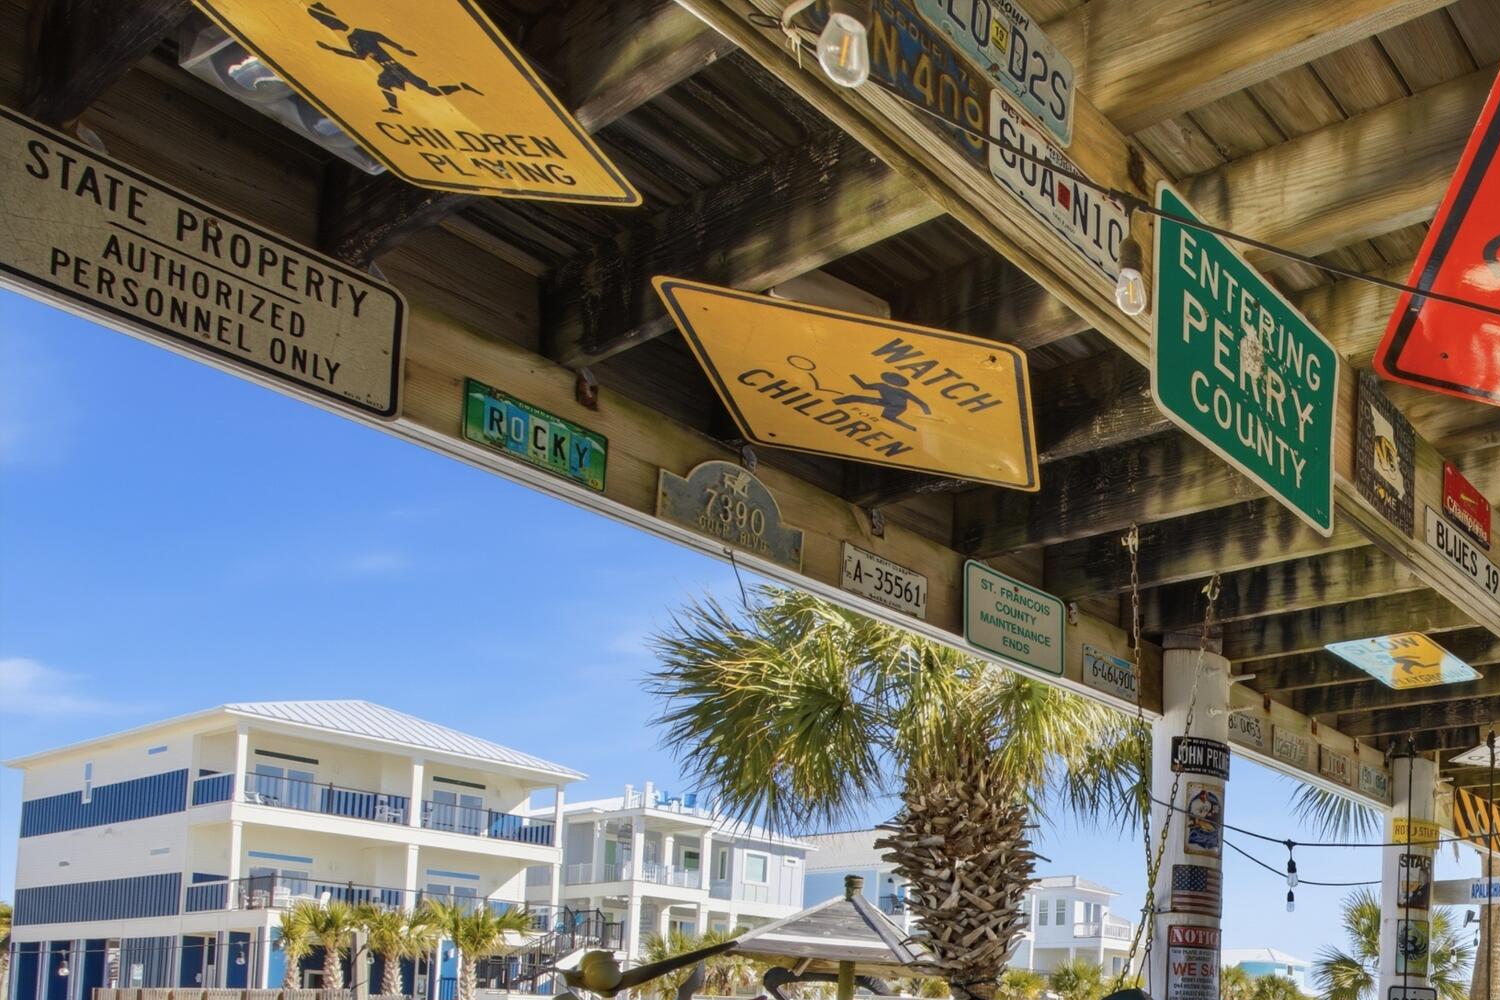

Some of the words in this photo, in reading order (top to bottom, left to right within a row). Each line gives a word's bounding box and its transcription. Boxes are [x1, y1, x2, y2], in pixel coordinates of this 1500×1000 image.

[375, 120, 567, 160] CHILDREN
[425, 151, 577, 187] PLAYING
[25, 140, 148, 227] STATE
[176, 207, 369, 319] PROPERTY
[102, 234, 306, 339] AUTHORIZED
[1178, 228, 1322, 393] ENTERING
[50, 247, 253, 353] PERSONNEL
[269, 337, 341, 386] ONLY
[870, 336, 1003, 415] WATCH
[1183, 289, 1315, 444] PERRY
[489, 406, 589, 469] ROCKY
[736, 367, 915, 459] CHILDREN
[1190, 369, 1308, 490] COUNTY
[705, 488, 766, 536] 7390
[852, 558, 922, 608] A-35561
[1436, 519, 1479, 577] BLUES
[1485, 563, 1500, 595] 19
[980, 577, 998, 596] ST.
[999, 586, 1051, 617] FRANCOIS
[995, 600, 1038, 626] COUNTY
[979, 610, 1052, 648] MAINTENANCE
[1002, 635, 1031, 656] ENDS
[1174, 744, 1205, 766] JOHN
[1172, 962, 1197, 977] WE
